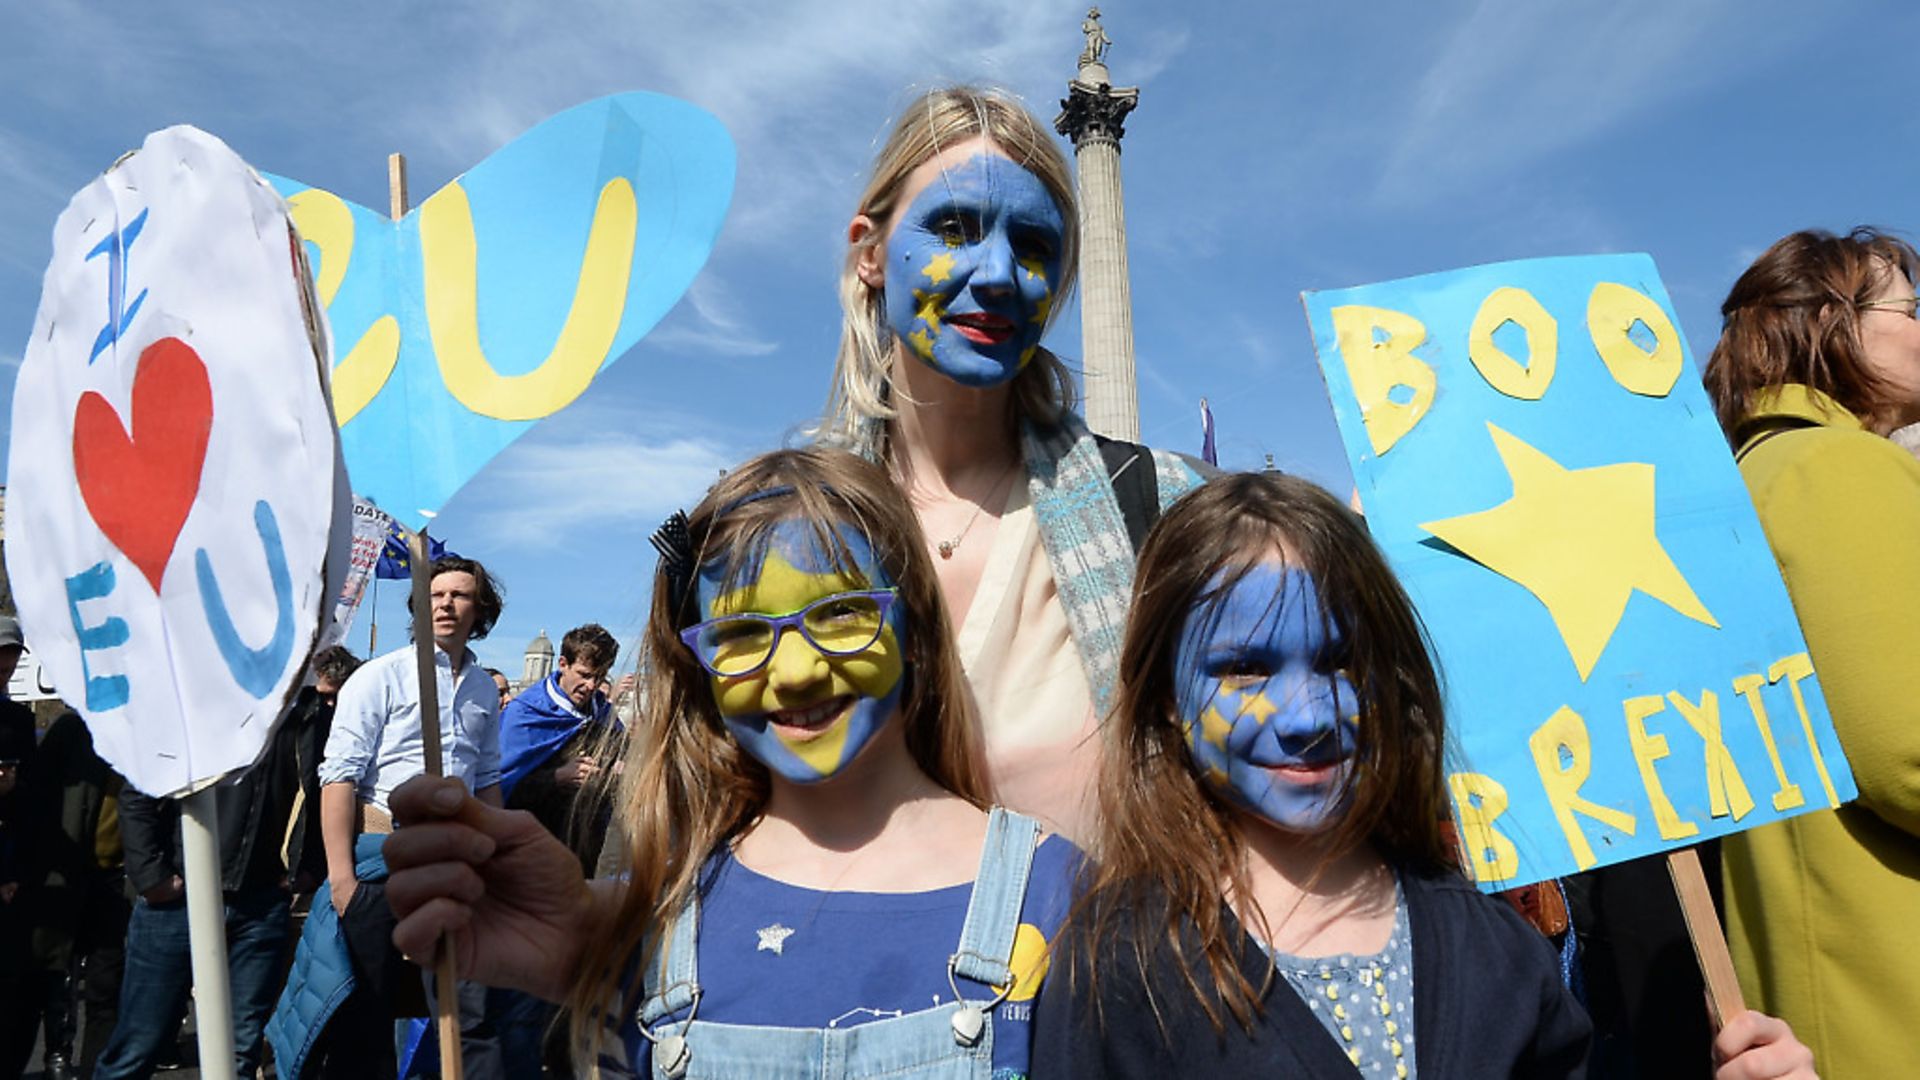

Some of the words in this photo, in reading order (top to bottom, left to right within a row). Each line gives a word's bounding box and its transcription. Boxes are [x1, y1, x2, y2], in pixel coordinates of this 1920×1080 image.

[85, 206, 148, 366] I
[1331, 281, 1683, 456] BOO
[1449, 652, 1842, 882] BREXIT
